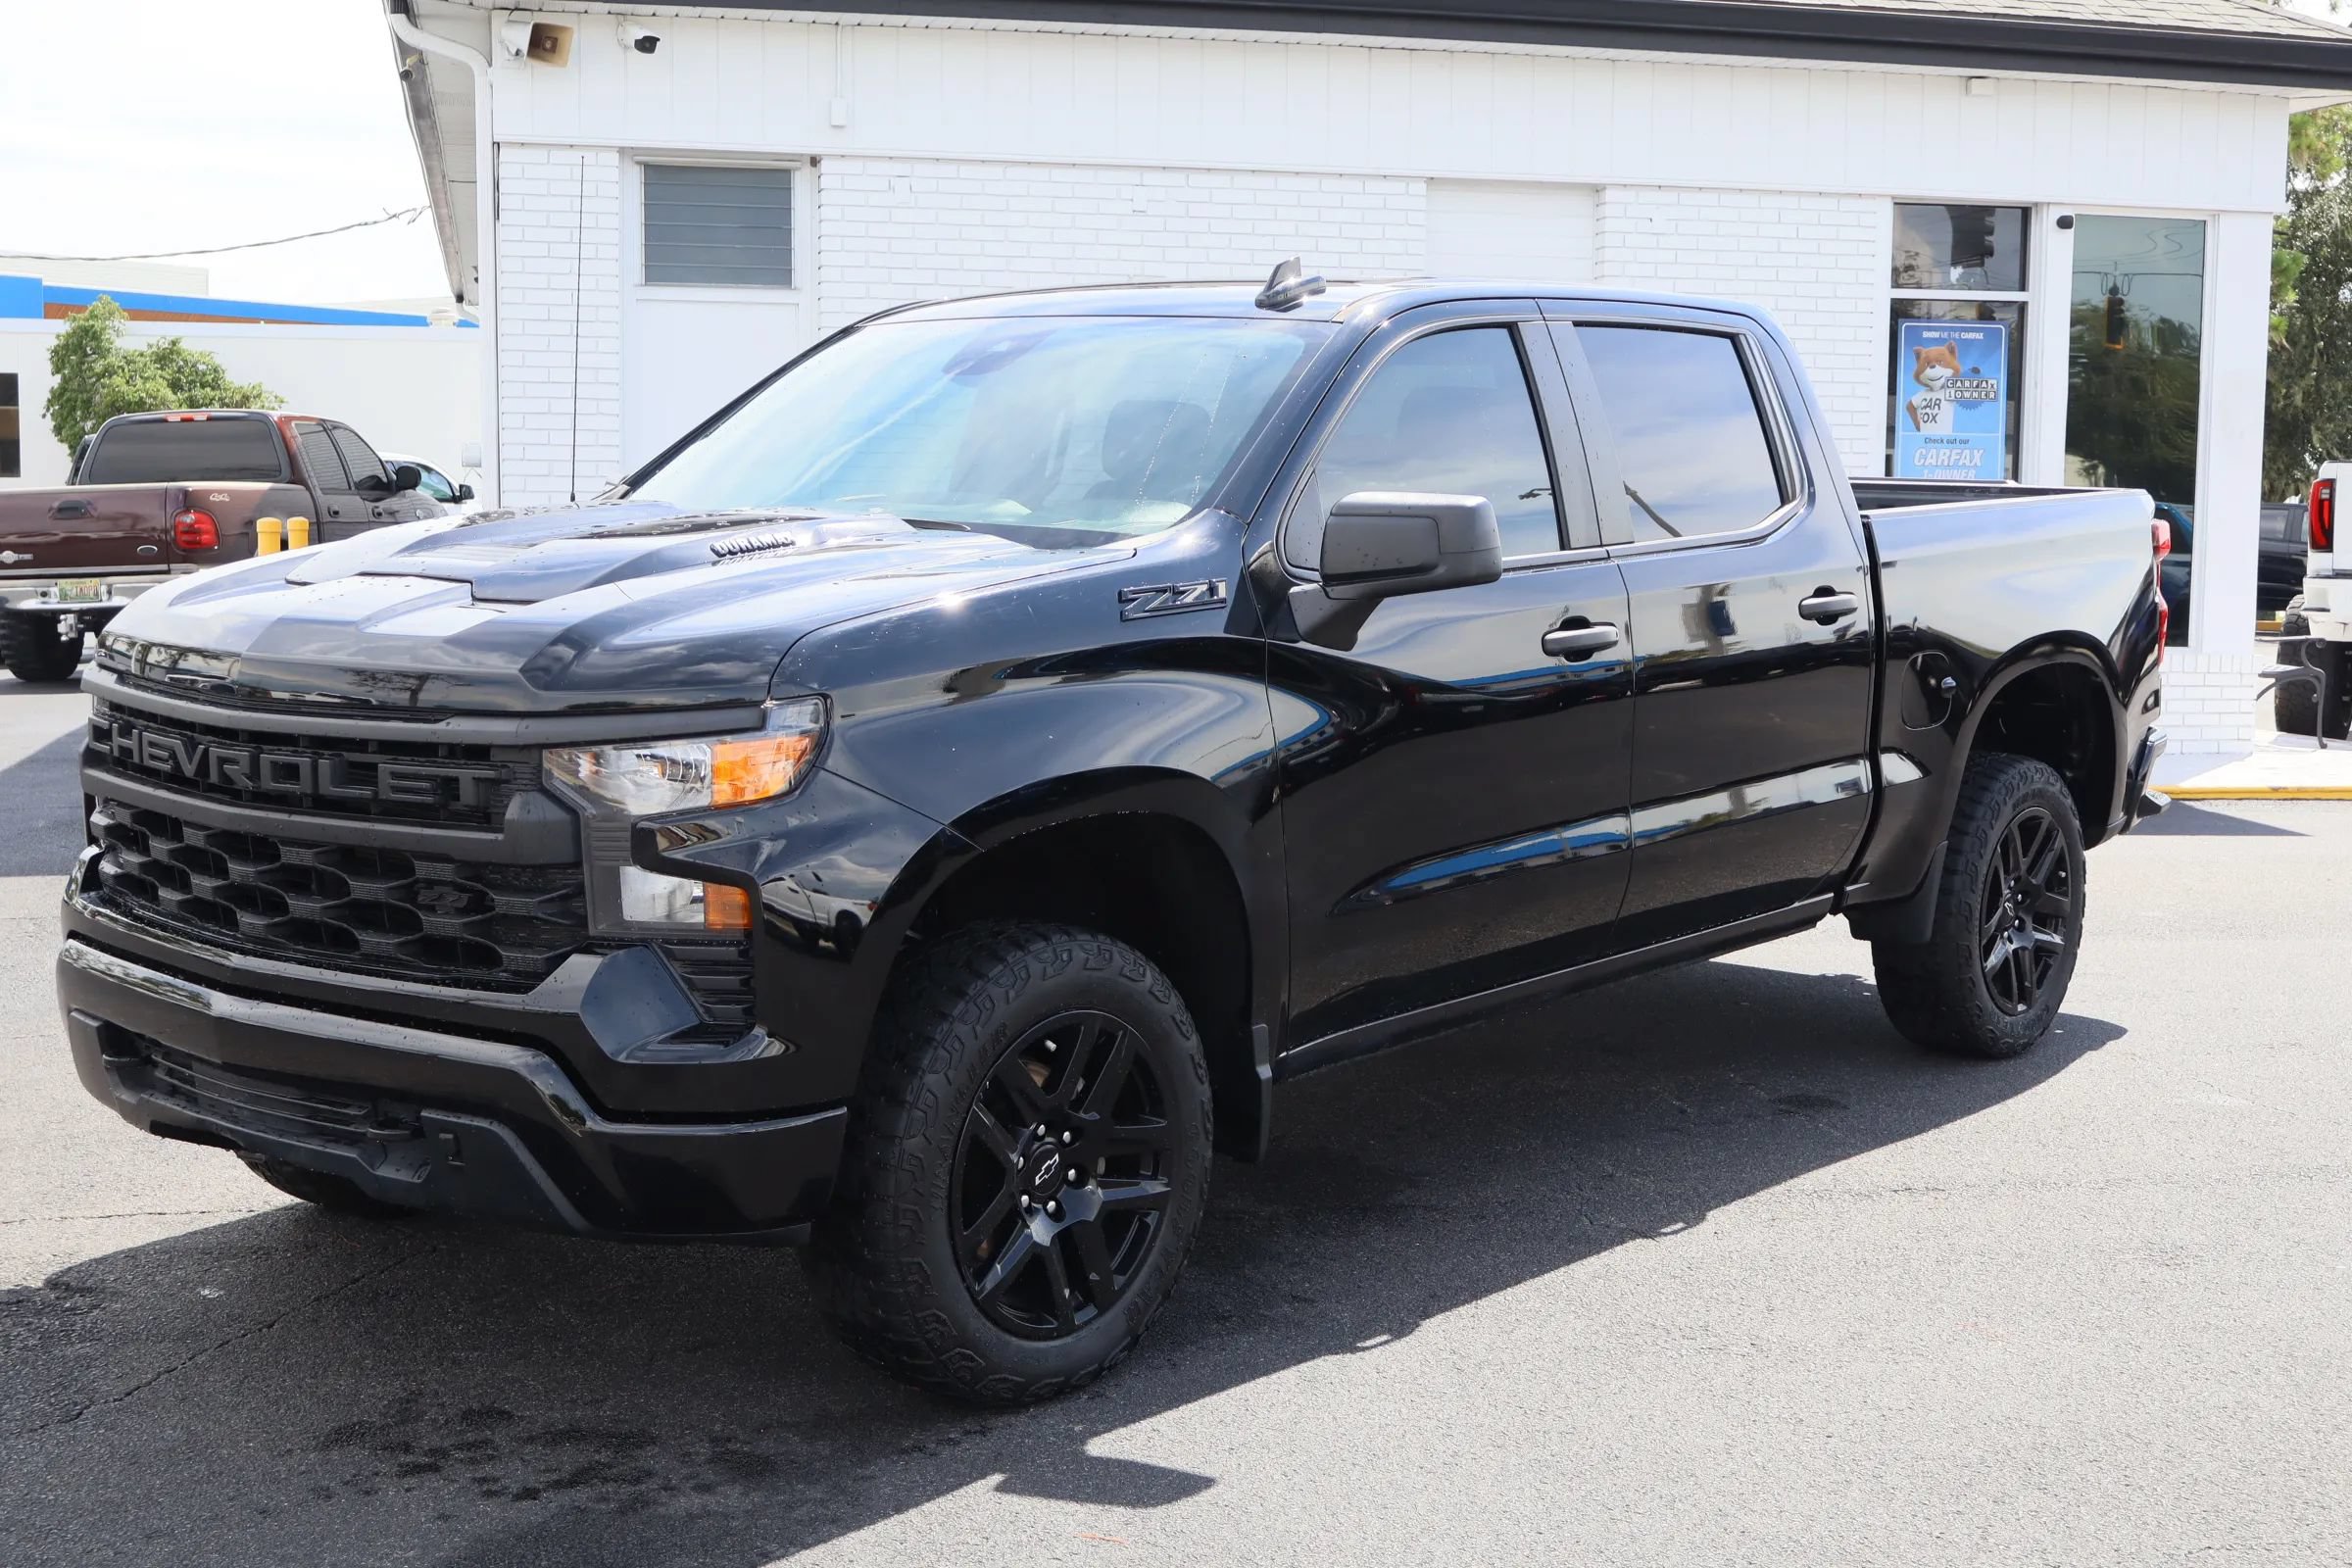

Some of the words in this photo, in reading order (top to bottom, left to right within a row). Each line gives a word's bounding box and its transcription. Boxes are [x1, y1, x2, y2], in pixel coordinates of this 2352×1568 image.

[1960, 331, 1984, 340] CARFAX
[1946, 378, 1997, 390] CARFAX
[1921, 397, 1941, 411] CAR
[1913, 447, 1984, 467] CARFAX
[1117, 577, 1227, 622] Z71
[87, 714, 497, 808] CHEVROLET
